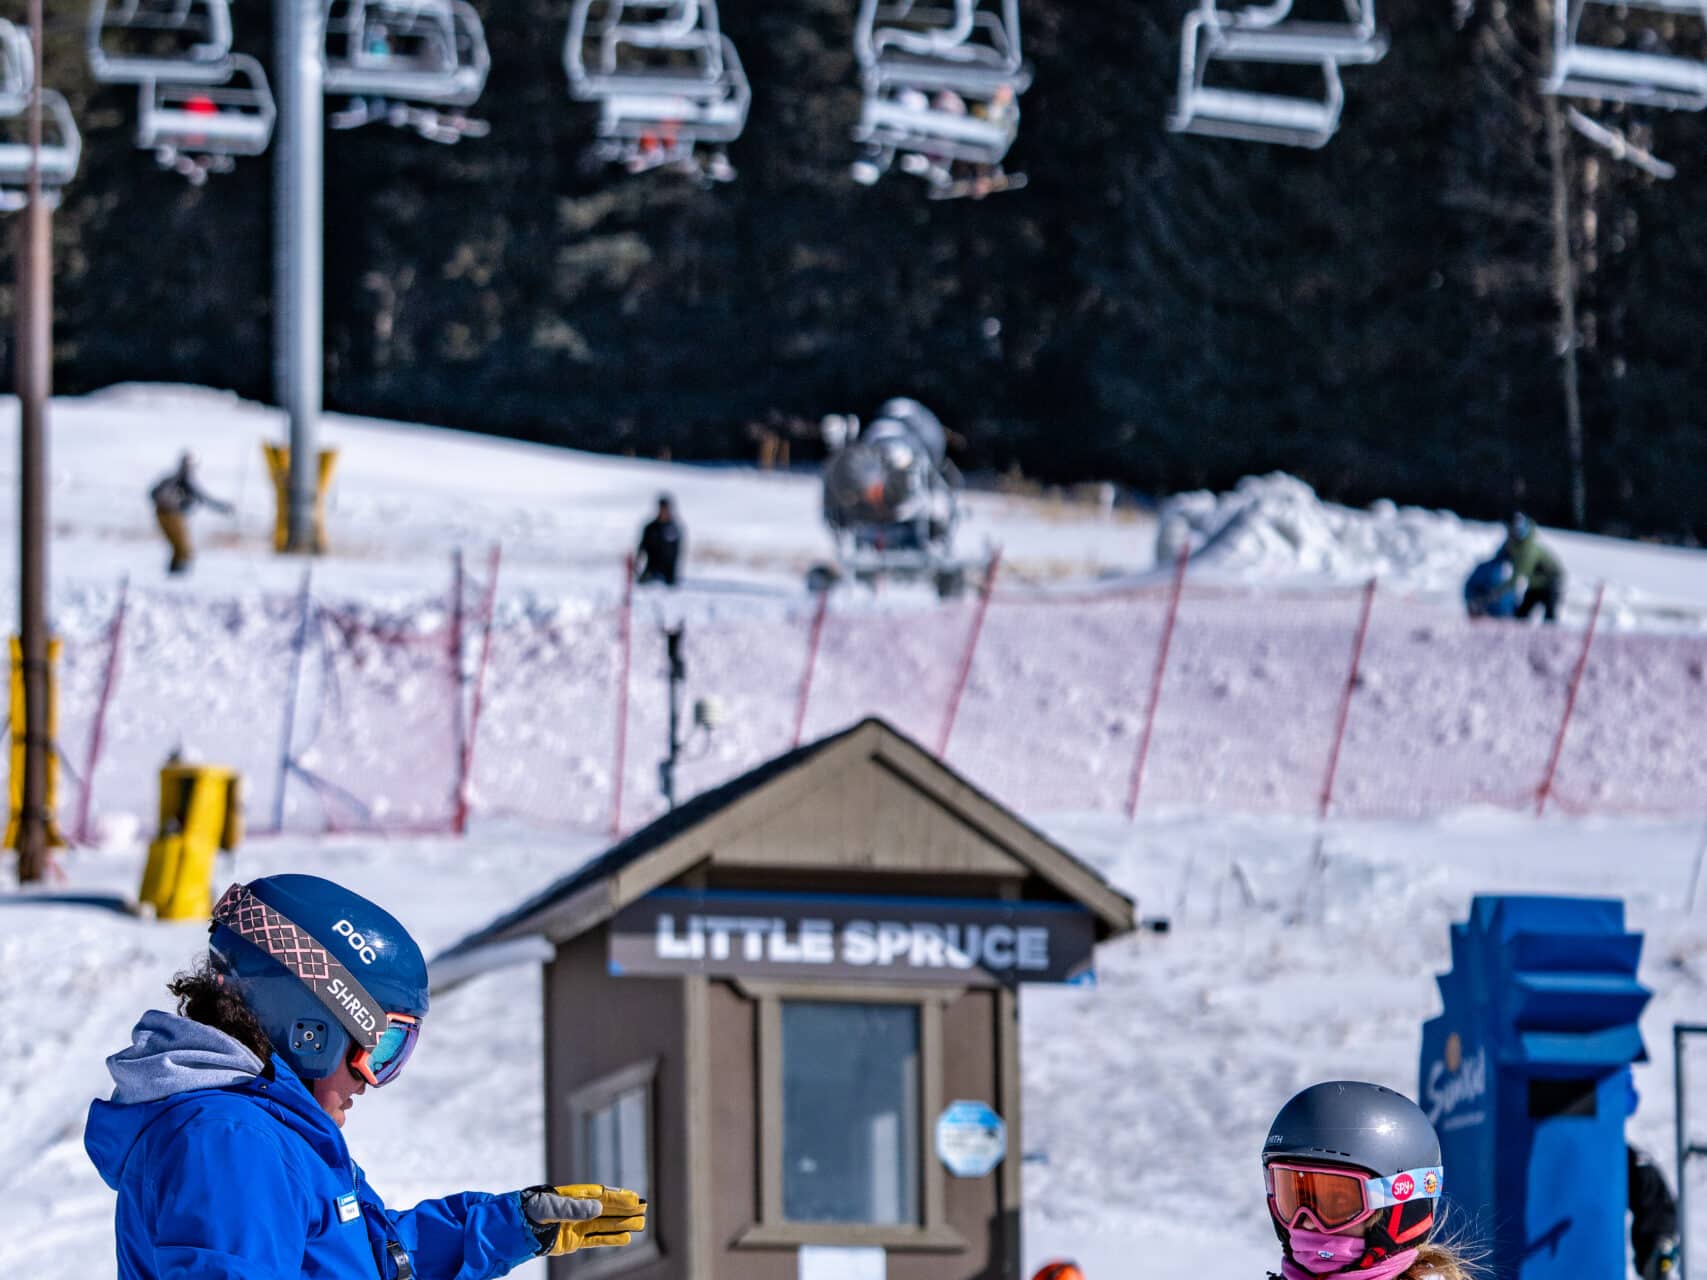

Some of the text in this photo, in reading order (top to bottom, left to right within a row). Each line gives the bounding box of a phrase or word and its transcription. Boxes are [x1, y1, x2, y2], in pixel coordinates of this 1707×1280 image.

[332, 919, 377, 966] POC
[656, 914, 1049, 970] LITTLE SPRUCE
